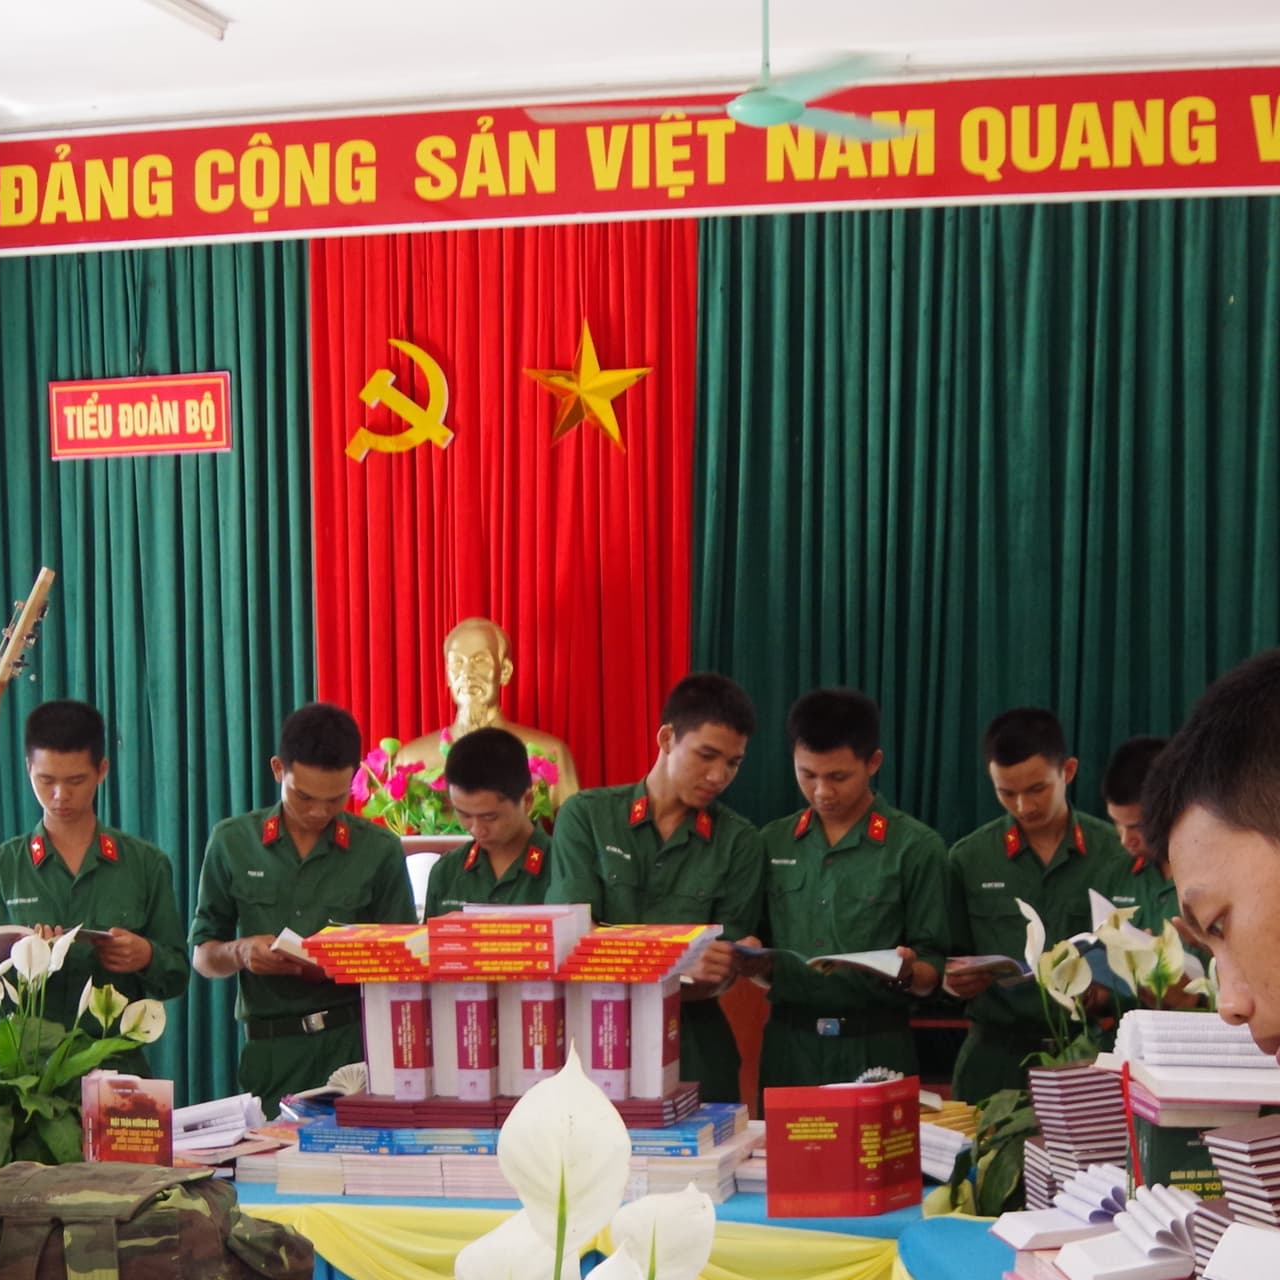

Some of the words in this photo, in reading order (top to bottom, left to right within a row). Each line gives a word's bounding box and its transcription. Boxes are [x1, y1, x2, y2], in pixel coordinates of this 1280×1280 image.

[194, 133, 377, 222] CỘNG
[415, 116, 556, 199] SẢN
[586, 111, 736, 198] VIỆT
[766, 110, 936, 182] NAM
[960, 96, 1217, 182] QUANG
[63, 391, 113, 440] TIỂU
[118, 394, 180, 438] ĐOÀN
[185, 391, 216, 441] BỘ
